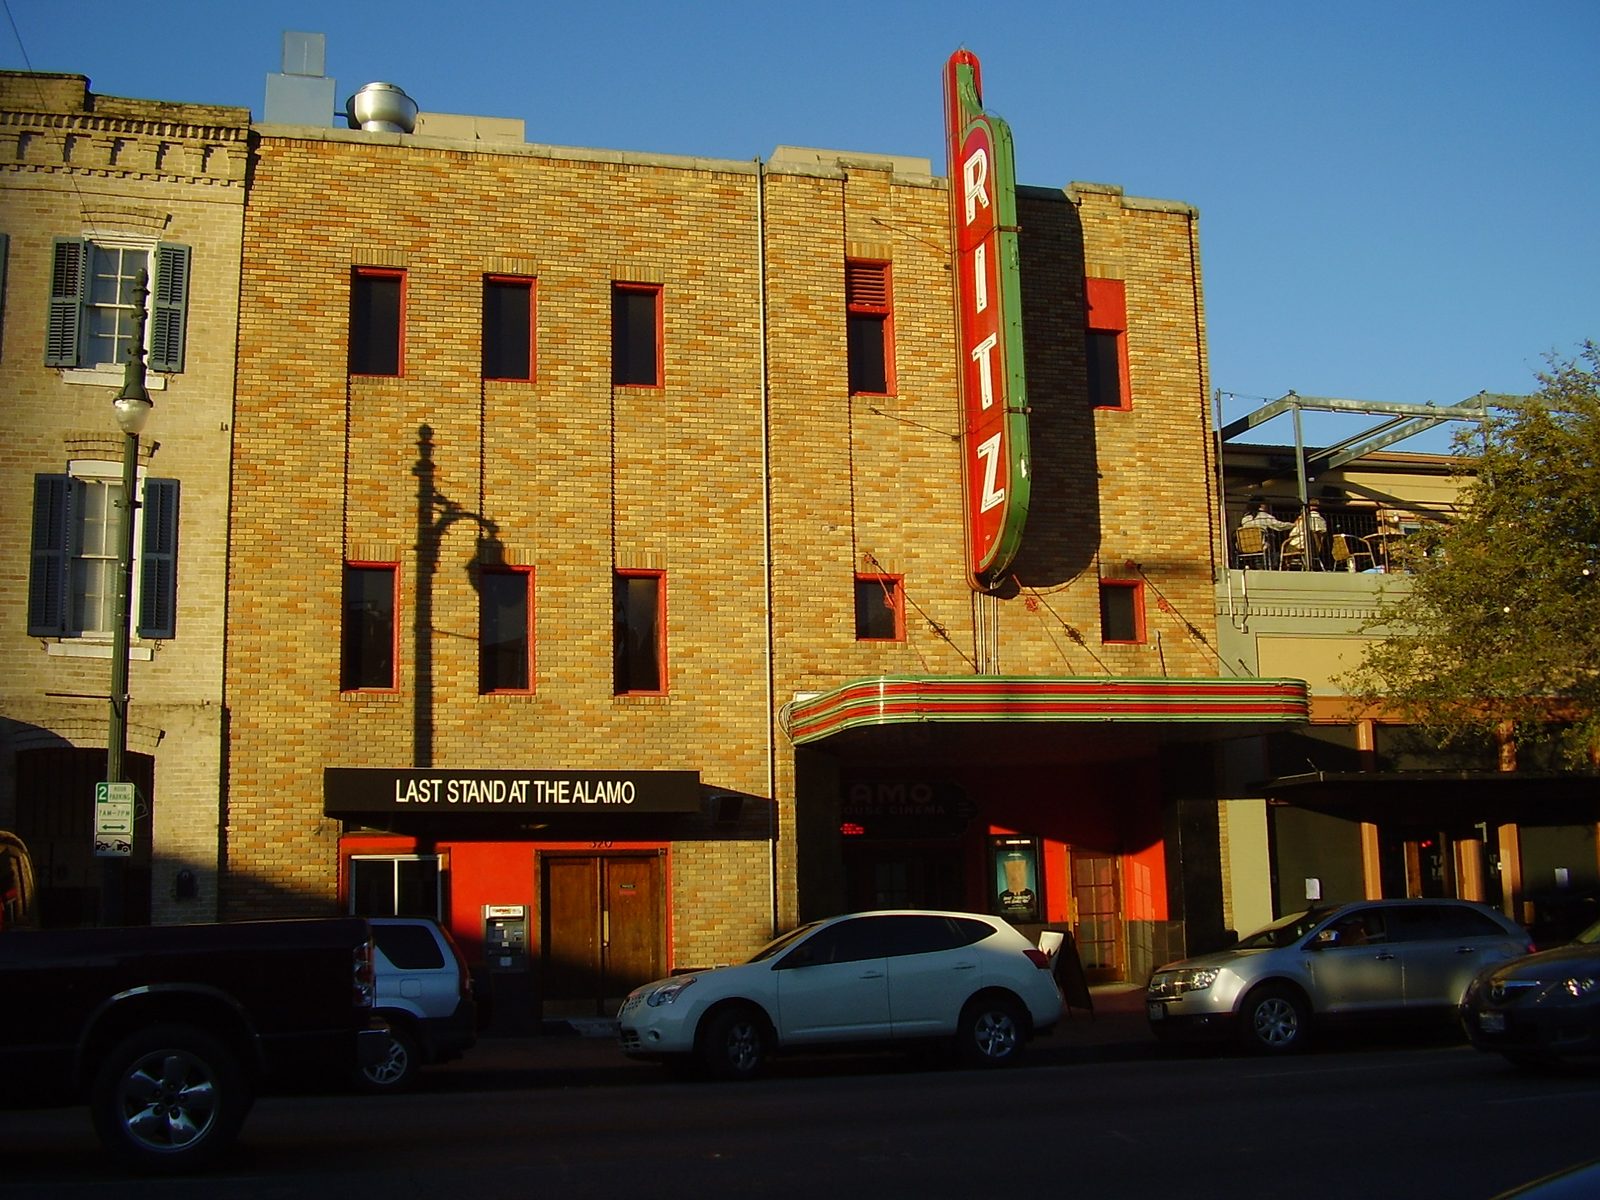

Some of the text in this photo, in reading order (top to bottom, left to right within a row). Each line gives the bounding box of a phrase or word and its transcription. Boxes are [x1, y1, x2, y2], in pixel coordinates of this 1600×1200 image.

[963, 147, 1005, 513] RITZ
[98, 785, 108, 801] 2
[109, 793, 131, 801] PARKING
[395, 778, 636, 805] LAST STAND AT THE ALAMO
[849, 783, 934, 804] AMO
[888, 805, 945, 815] CINEMA
